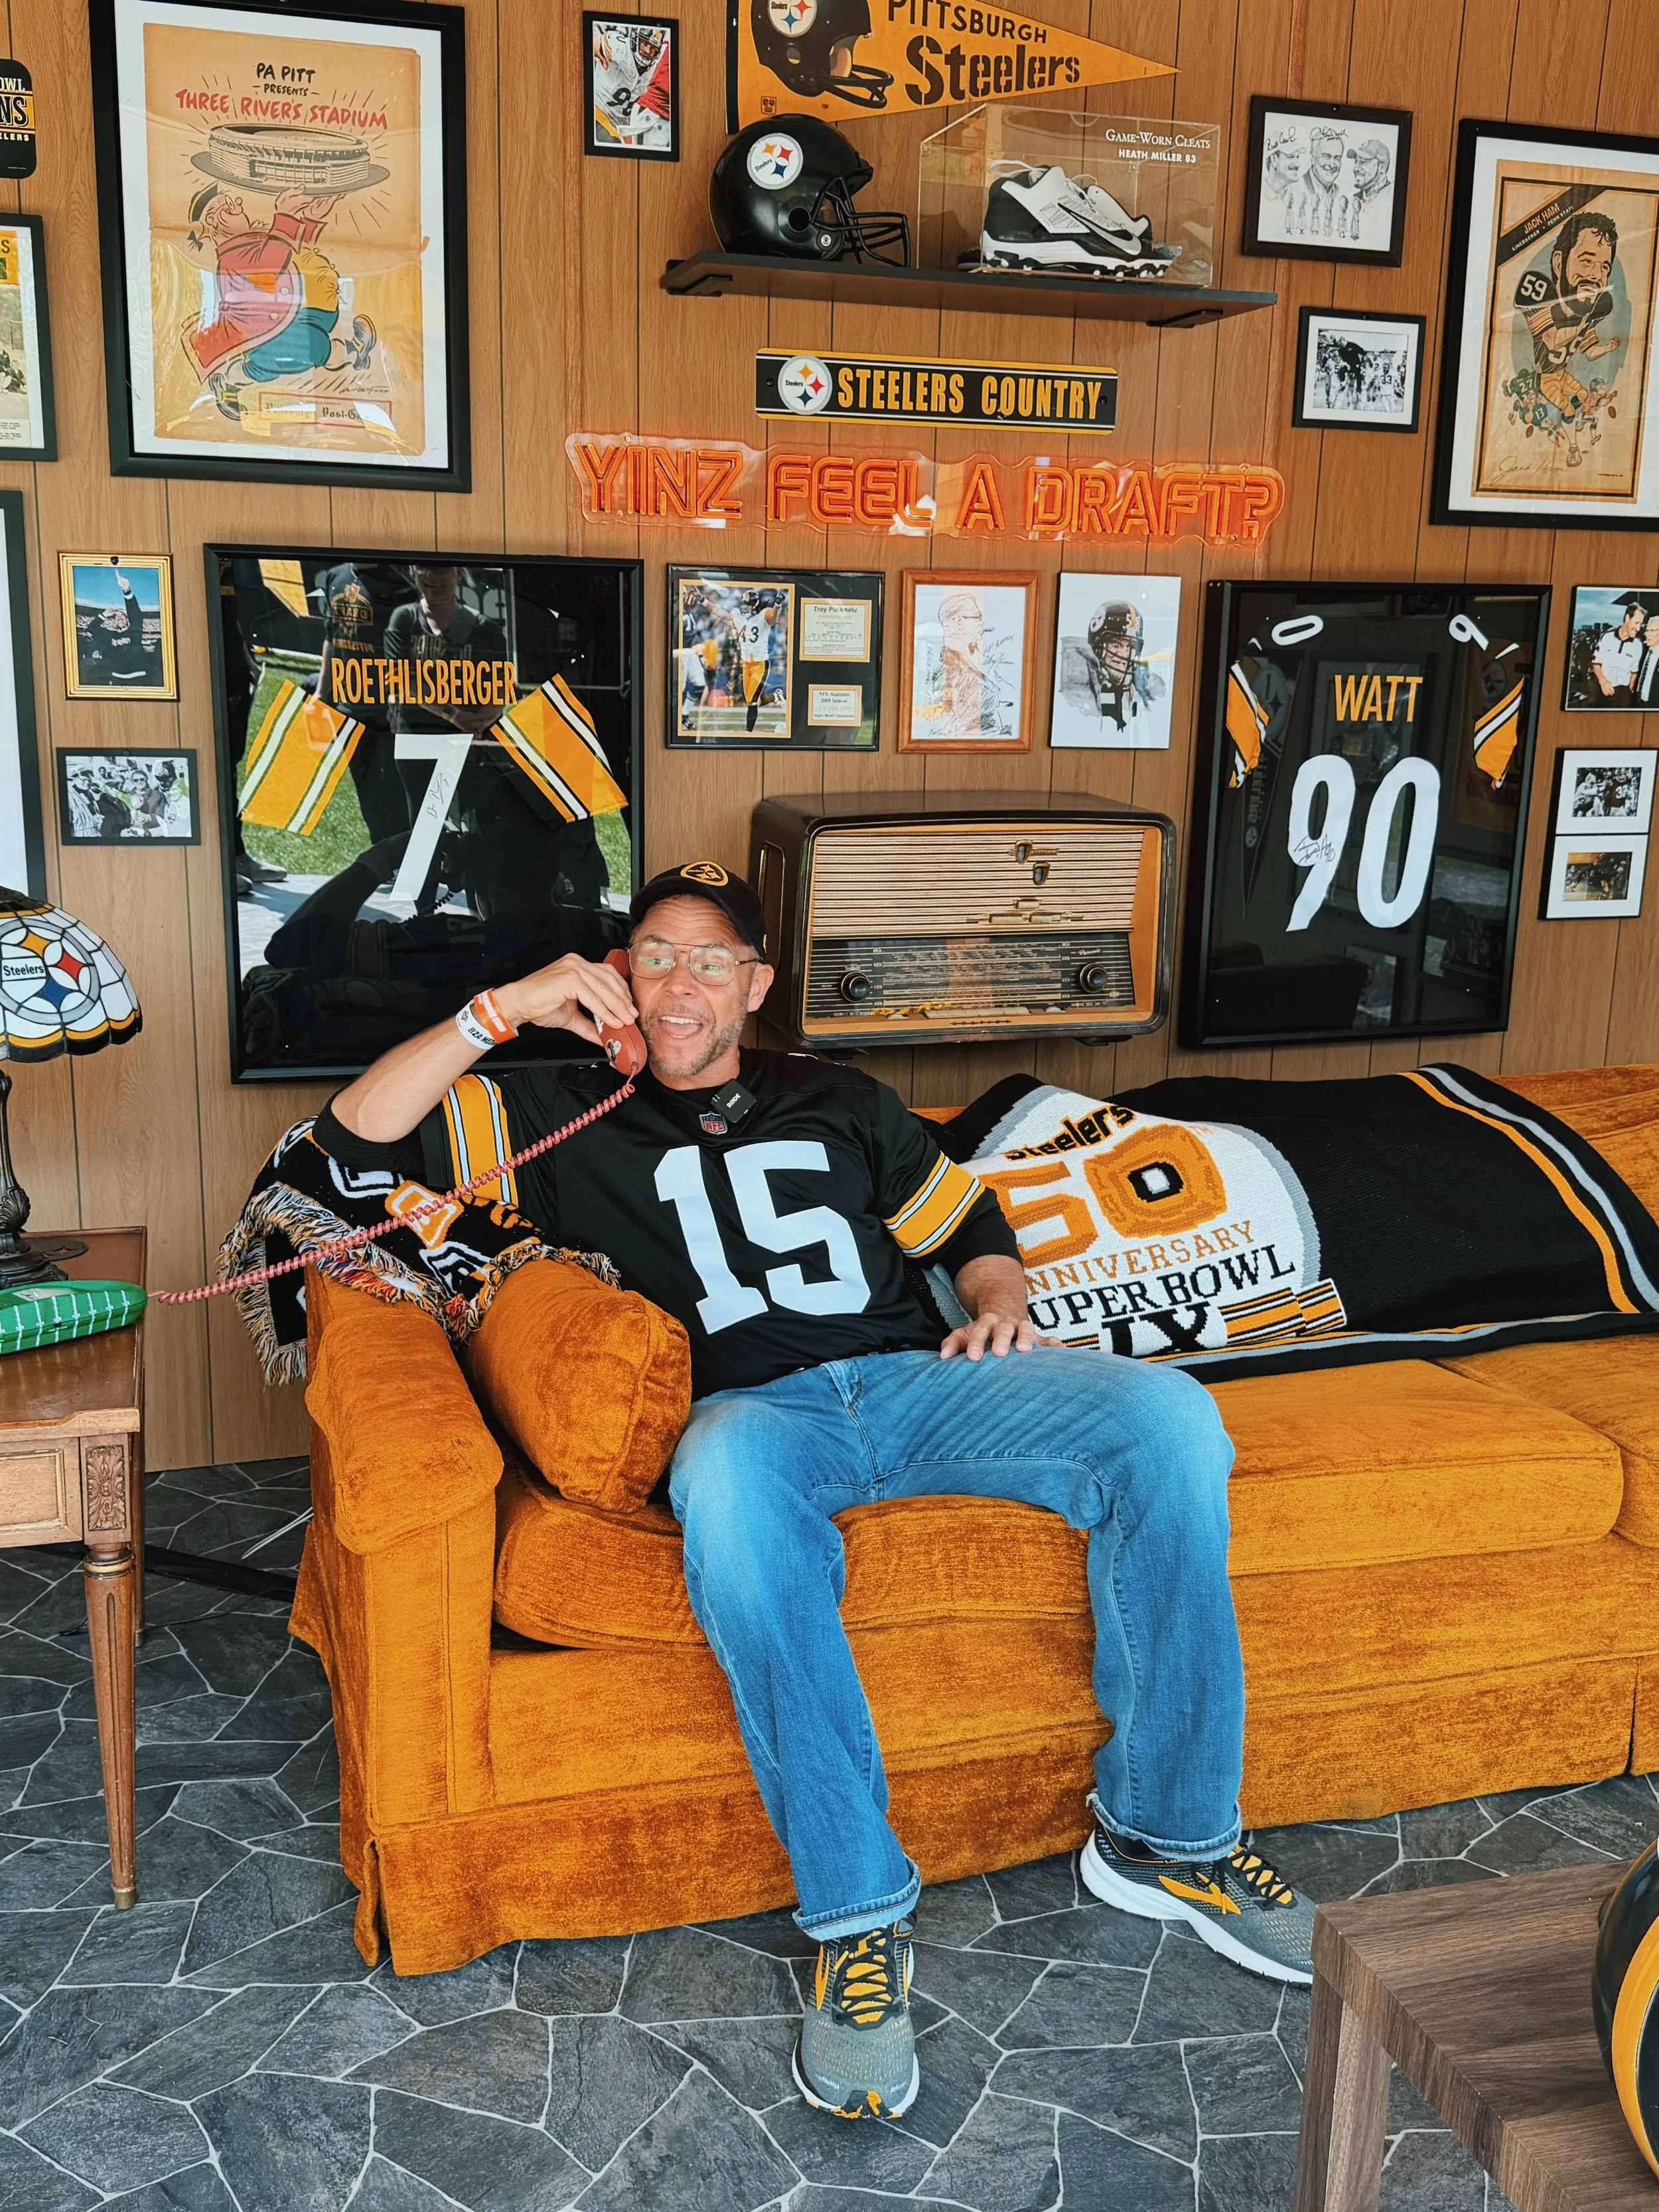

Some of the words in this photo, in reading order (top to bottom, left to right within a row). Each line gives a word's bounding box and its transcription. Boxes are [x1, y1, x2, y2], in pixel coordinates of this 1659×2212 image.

[888, 0, 1046, 44] PITTSBURGH
[257, 62, 275, 80] PA
[281, 66, 316, 83] PITT
[264, 84, 308, 96] PRESENTS
[905, 35, 1080, 106] Steelers
[175, 88, 229, 113] THREE
[241, 97, 303, 119] RIVERS
[309, 105, 388, 129] STADIUM
[755, 159, 772, 172] Steelers
[1118, 149, 1148, 160] HEATH
[1151, 152, 1182, 163] MILLER
[1185, 155, 1196, 163] 83
[1524, 216, 1542, 234] JACK
[1542, 203, 1559, 221] HAM
[1521, 274, 1548, 301] 59
[838, 367, 964, 413] STEELERS
[981, 375, 1102, 419] COUNTRY
[1519, 379, 1533, 392] 27
[1535, 408, 1544, 419] 13
[574, 443, 743, 519] YINZ
[766, 453, 932, 528] FEEL
[956, 463, 1005, 531] A
[1025, 465, 1279, 538] DRAFT?
[739, 625, 758, 643] 43
[332, 658, 517, 705] ROETHLISBERGER
[1334, 674, 1423, 723] WATT
[389, 733, 474, 901] 7
[1285, 754, 1441, 932] 90
[3, 963, 44, 976] Steelers
[468, 1027, 483, 1040] BZA
[705, 1122, 725, 1131] NFL
[1004, 1104, 1137, 1161] Steelers
[979, 1124, 1228, 1268] 50
[654, 1140, 871, 1335] 15
[1026, 1220, 1255, 1295] NNIVERSARY
[1029, 1282, 1163, 1329] UPER
[1158, 1244, 1296, 1307] BOWL
